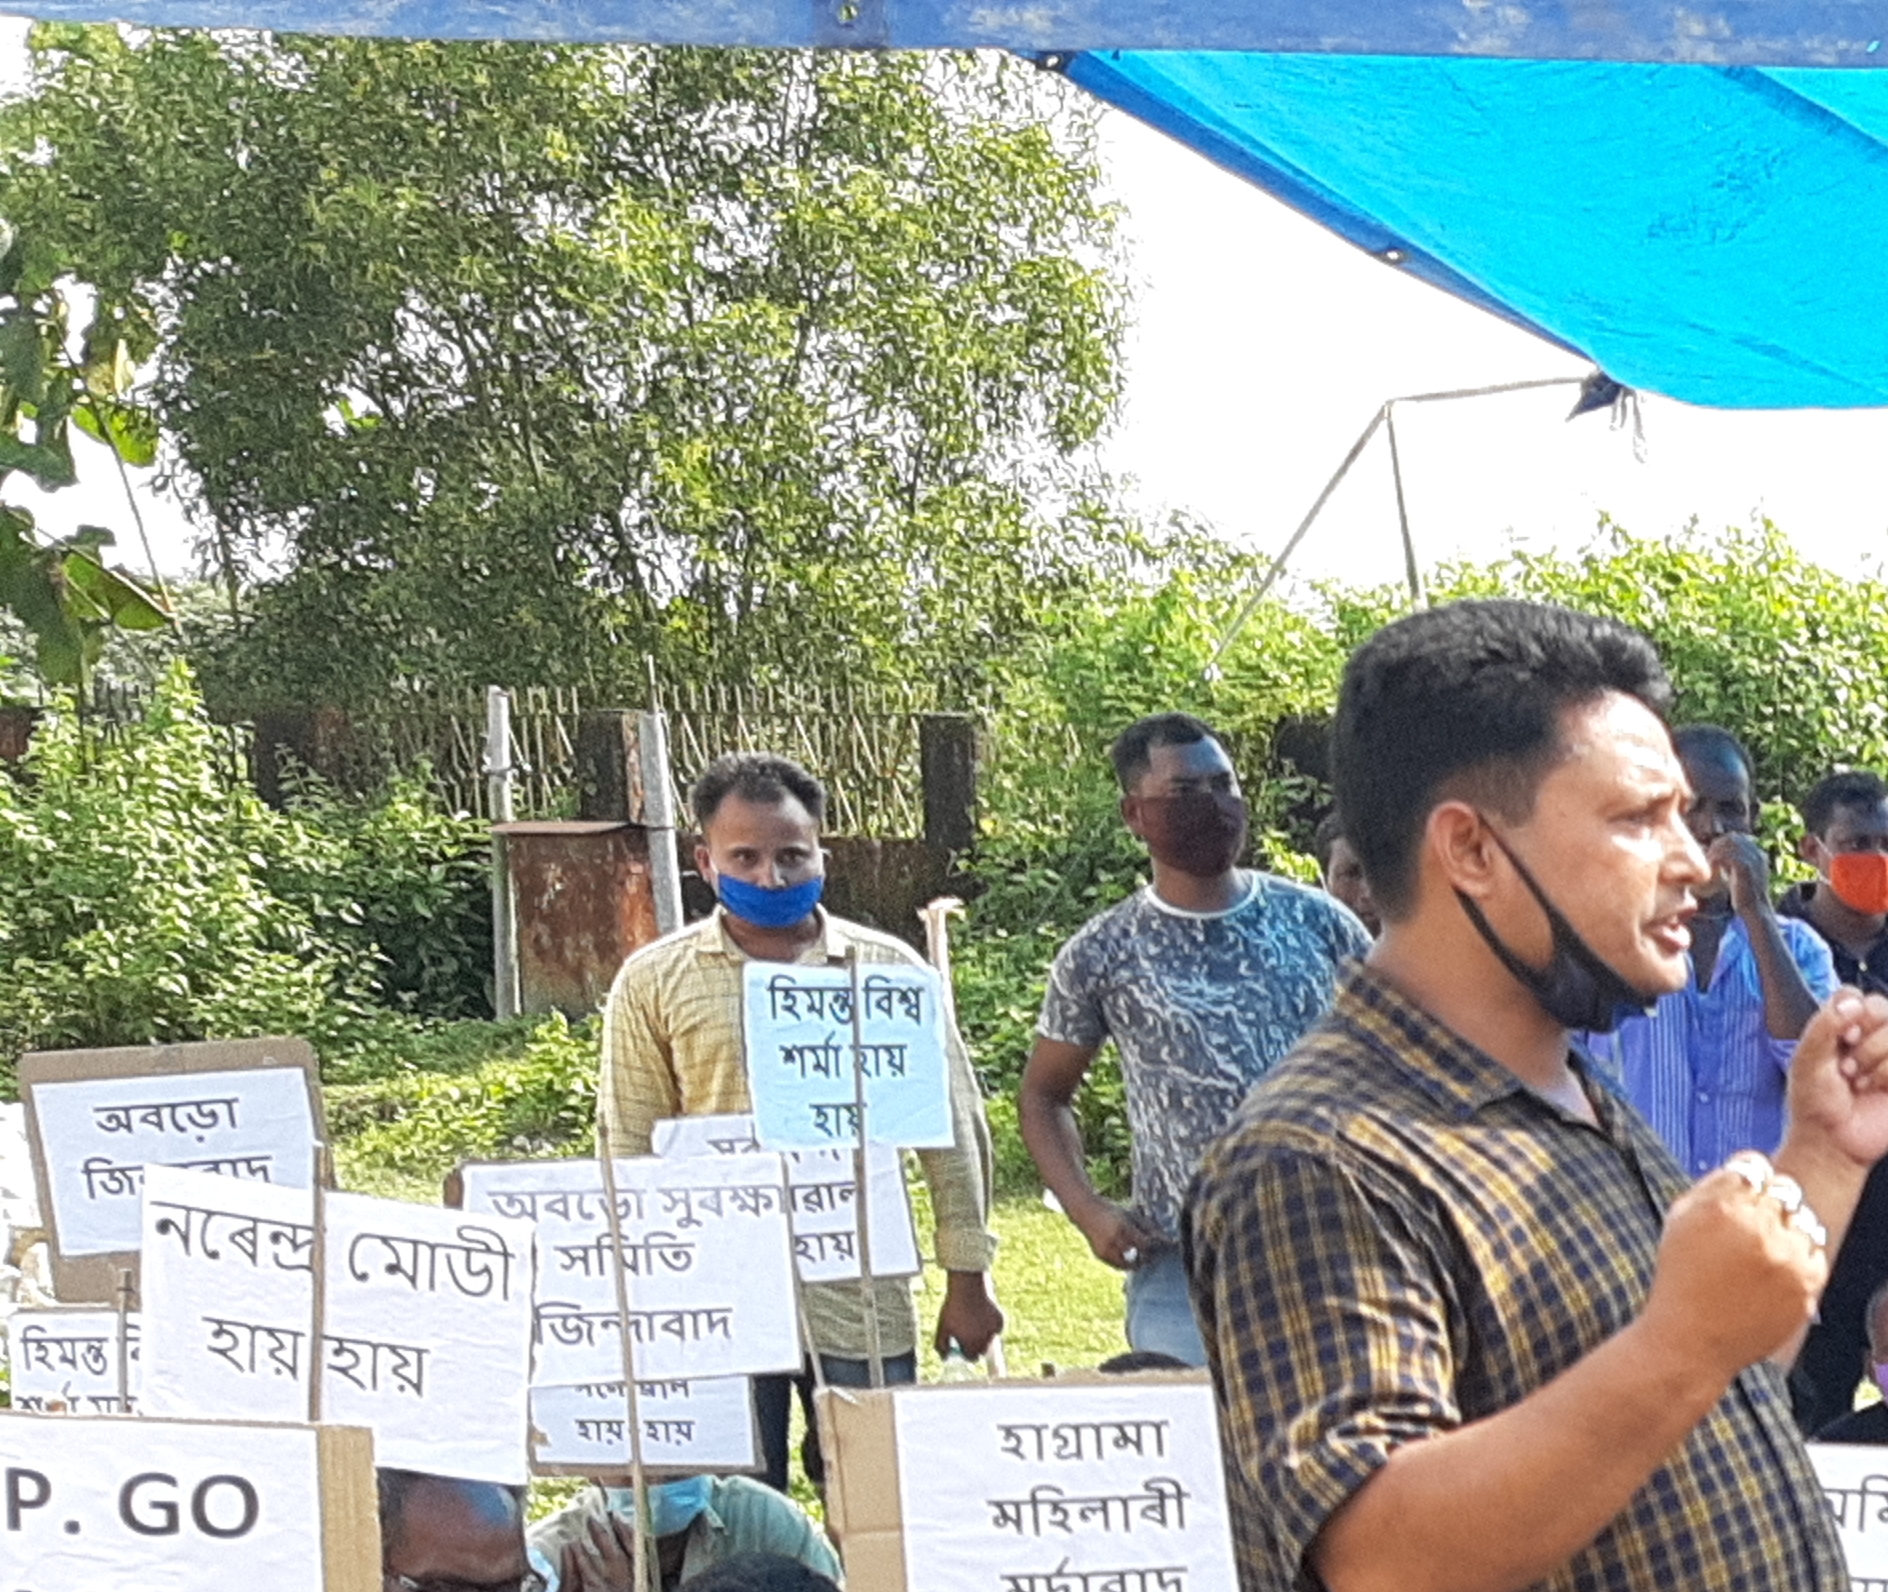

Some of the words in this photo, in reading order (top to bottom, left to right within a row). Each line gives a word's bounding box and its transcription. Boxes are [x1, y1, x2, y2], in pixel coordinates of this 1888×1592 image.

[862, 974, 924, 1026] বিশ্ব
[92, 1097, 240, 1143] অবড়ো
[554, 1231, 696, 1277] সমিতি
[202, 1316, 306, 1381] হায়
[321, 1333, 431, 1398] হায়
[575, 1419, 625, 1446] হায়
[643, 1420, 695, 1447] হায়
[118, 1471, 260, 1539] GO
